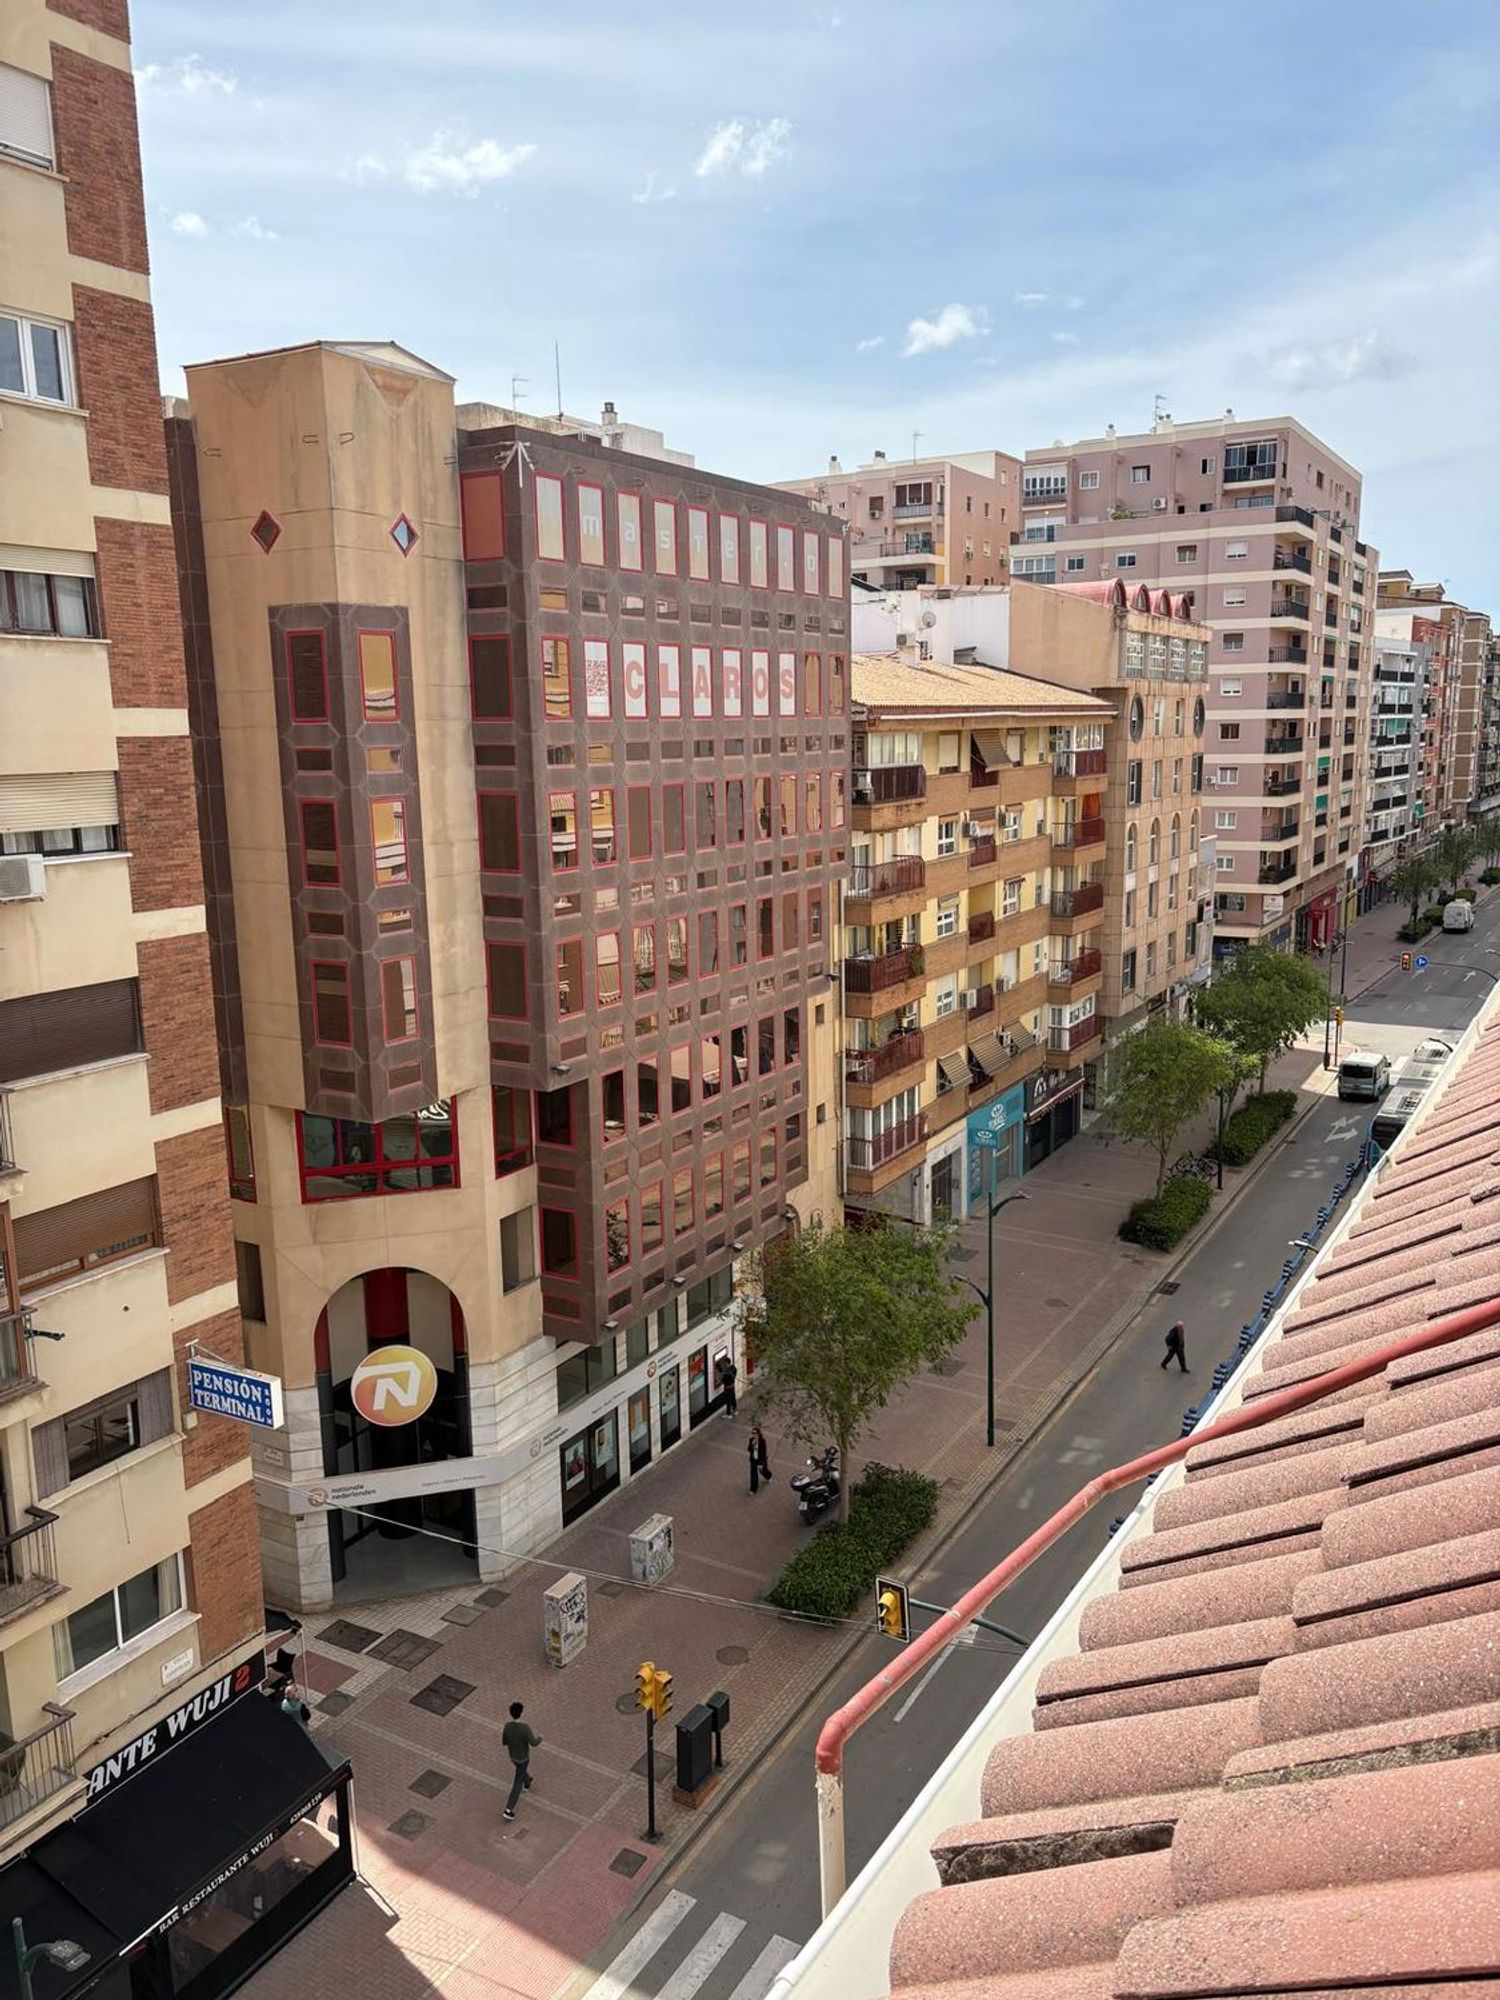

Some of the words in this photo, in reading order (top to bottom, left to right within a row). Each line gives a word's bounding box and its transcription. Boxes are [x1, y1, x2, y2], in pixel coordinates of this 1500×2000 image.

[625, 660, 794, 700] CLAROS
[192, 1370, 262, 1403] PENSIÓN
[194, 1389, 265, 1422] TERMINAL
[166, 1674, 233, 1739] WUJI
[234, 1664, 250, 1692] 2
[158, 1911, 180, 1934] BAR
[181, 1852, 250, 1914] RESTAURANTE
[250, 1832, 275, 1856] WUJI
